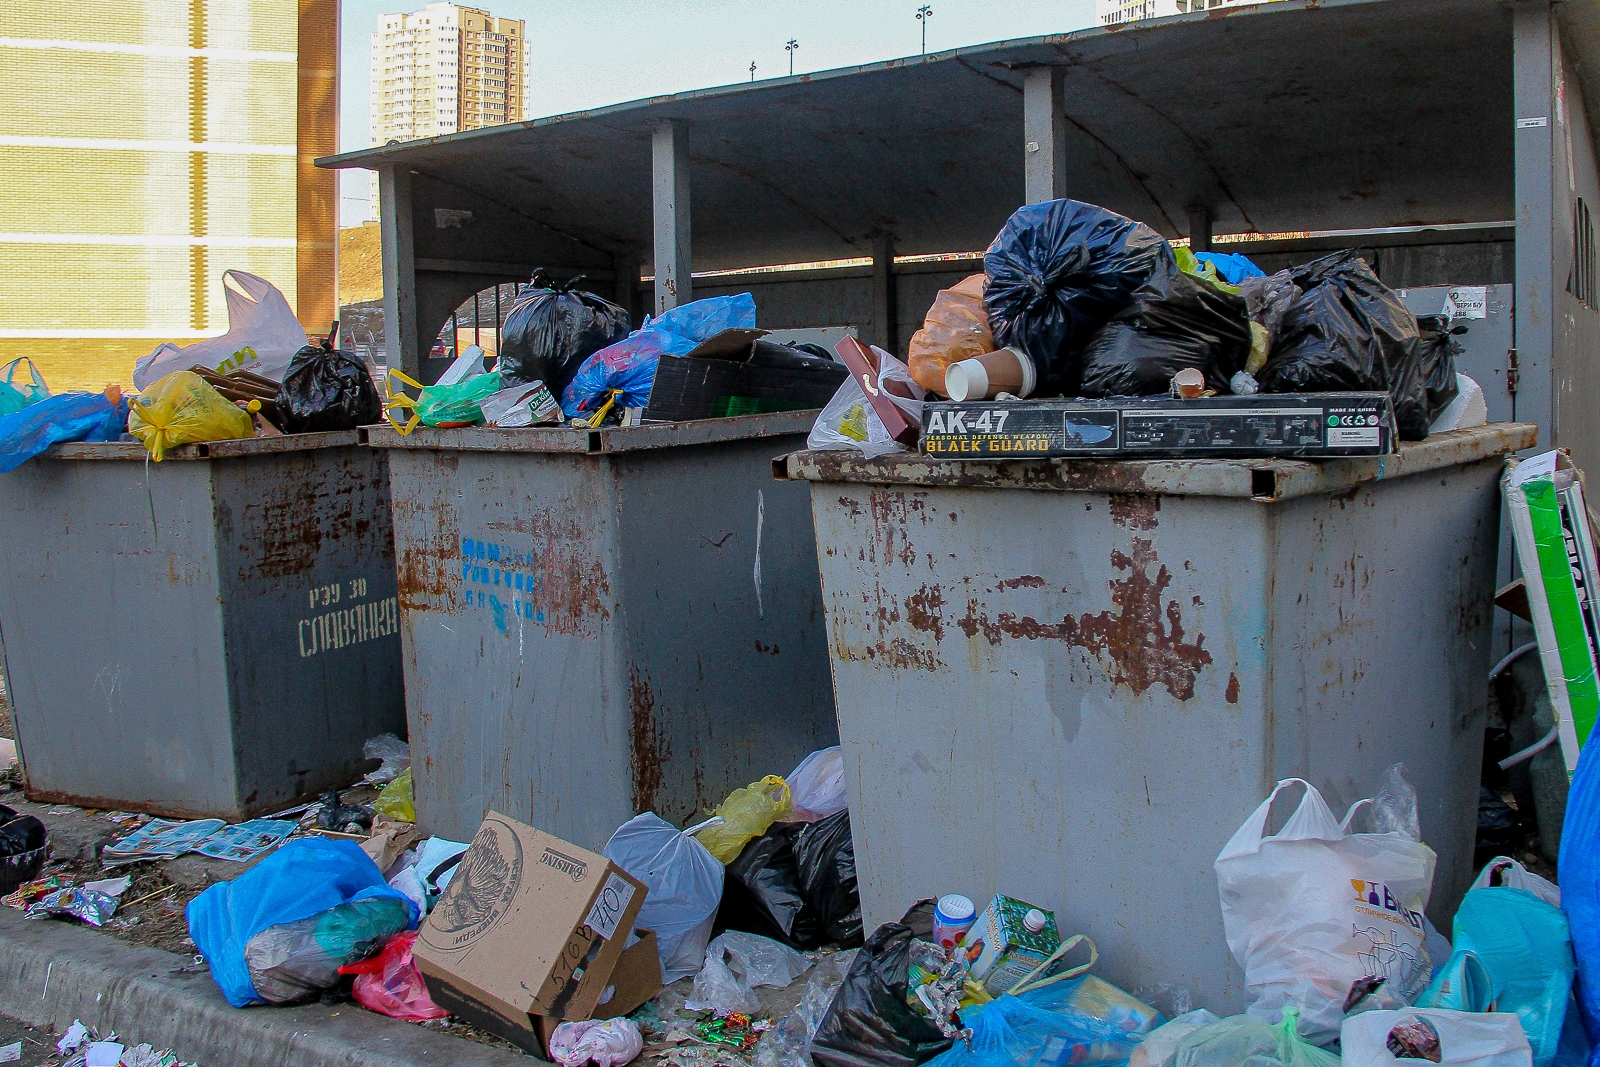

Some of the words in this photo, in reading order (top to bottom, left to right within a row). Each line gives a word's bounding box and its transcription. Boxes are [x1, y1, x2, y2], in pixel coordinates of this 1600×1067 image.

[926, 410, 1010, 434] AK-47
[926, 440, 981, 452] BLACK
[989, 440, 1050, 451] GUARD
[309, 583, 341, 609] РЭУ
[349, 578, 368, 600] 30
[299, 596, 398, 658] СЛАВЯНКА
